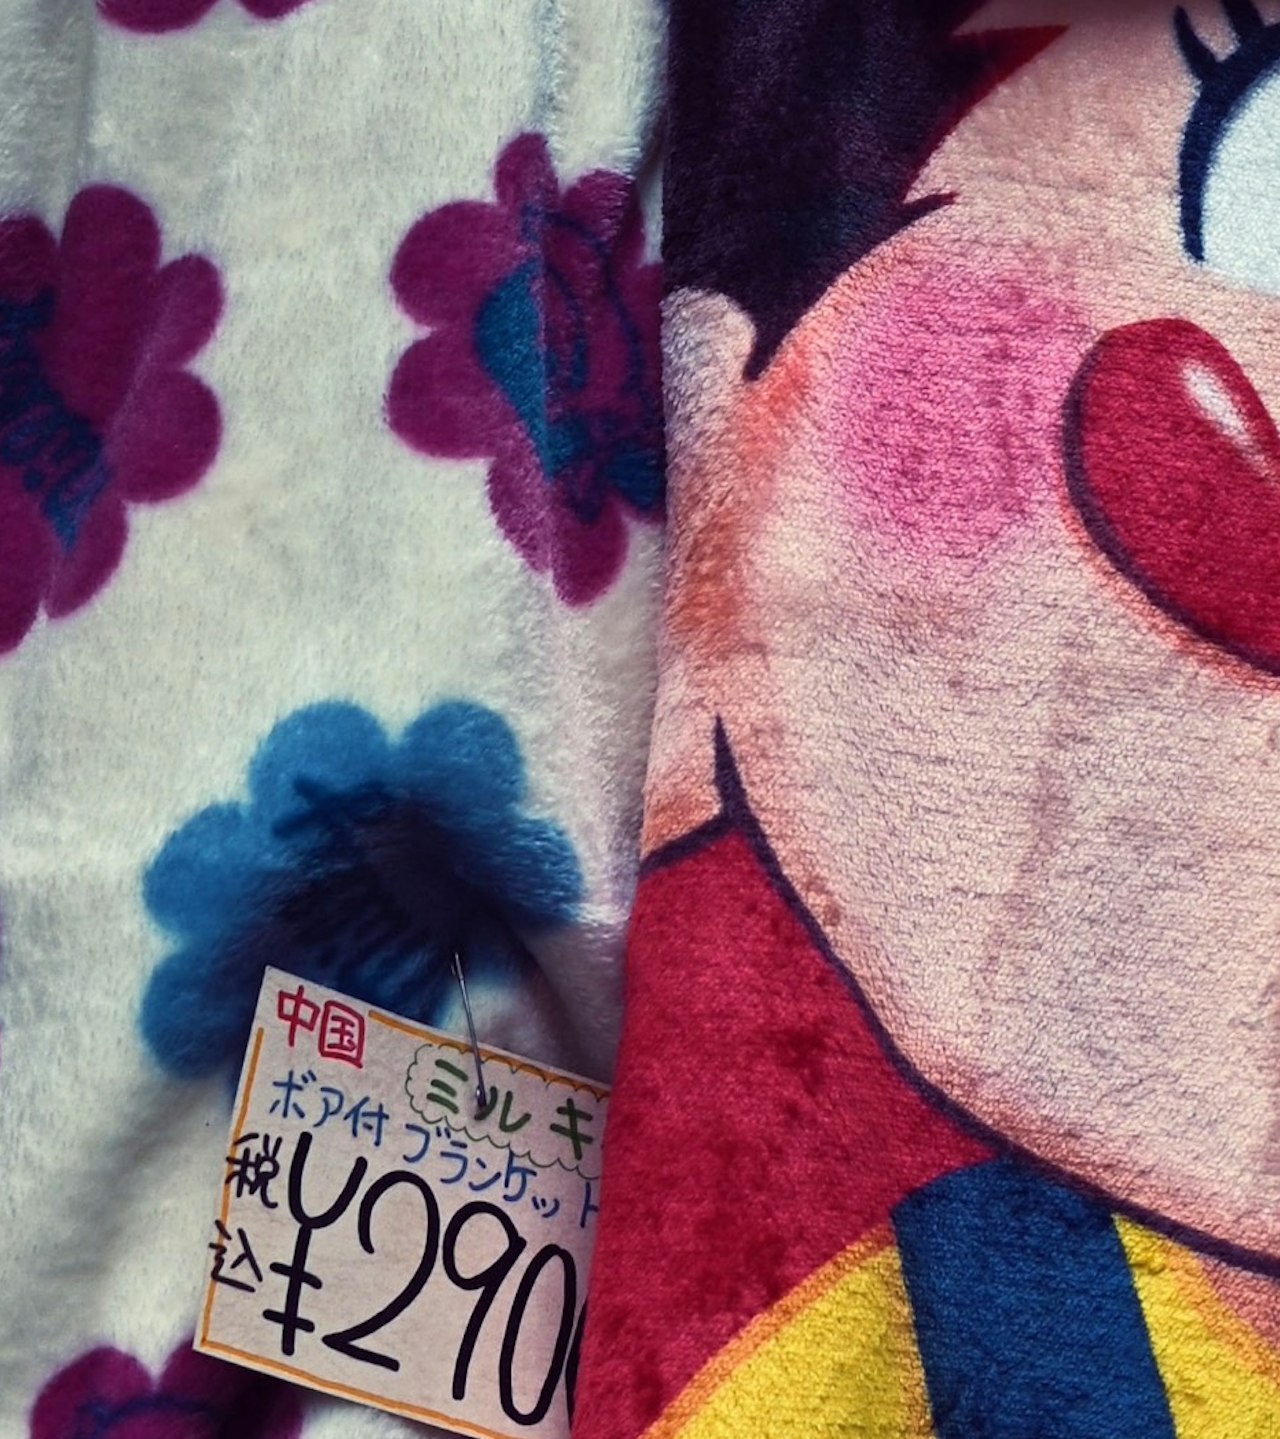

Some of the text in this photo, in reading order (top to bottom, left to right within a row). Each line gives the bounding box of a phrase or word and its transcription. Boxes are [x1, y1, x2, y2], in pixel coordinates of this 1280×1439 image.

[276, 984, 365, 1070] 中国
[208, 1132, 283, 1293] 税込
[262, 1131, 587, 1426] ¥290
